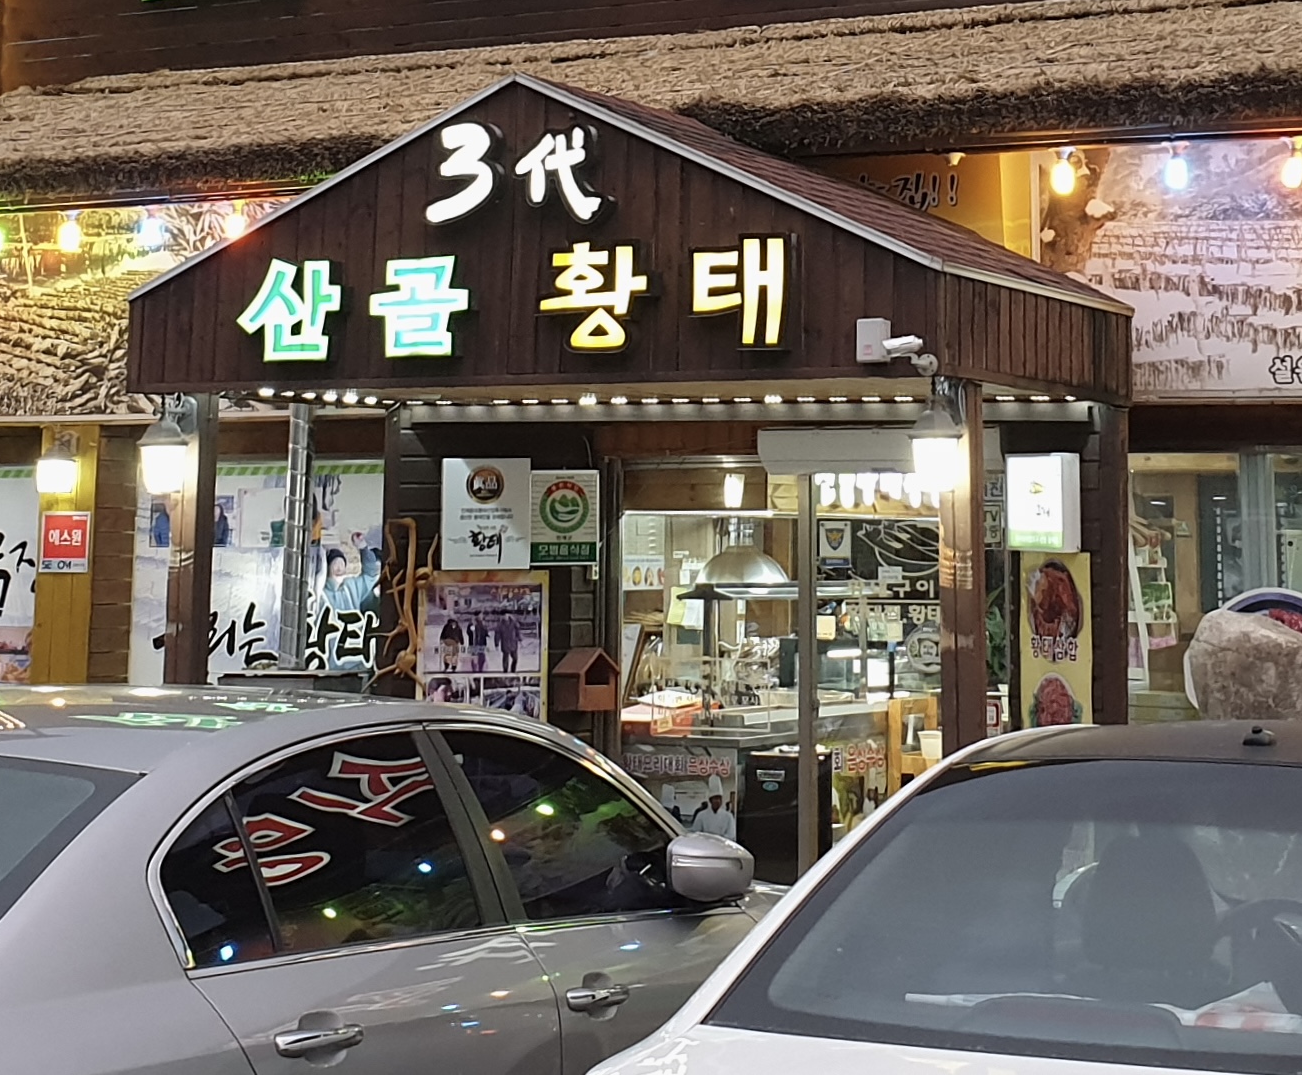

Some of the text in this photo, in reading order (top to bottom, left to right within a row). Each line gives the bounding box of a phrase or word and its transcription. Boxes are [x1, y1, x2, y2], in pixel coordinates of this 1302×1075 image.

[236, 237, 789, 362] 산골 황태
[49, 529, 82, 546] 에스원
[538, 544, 590, 556] 모범음식점
